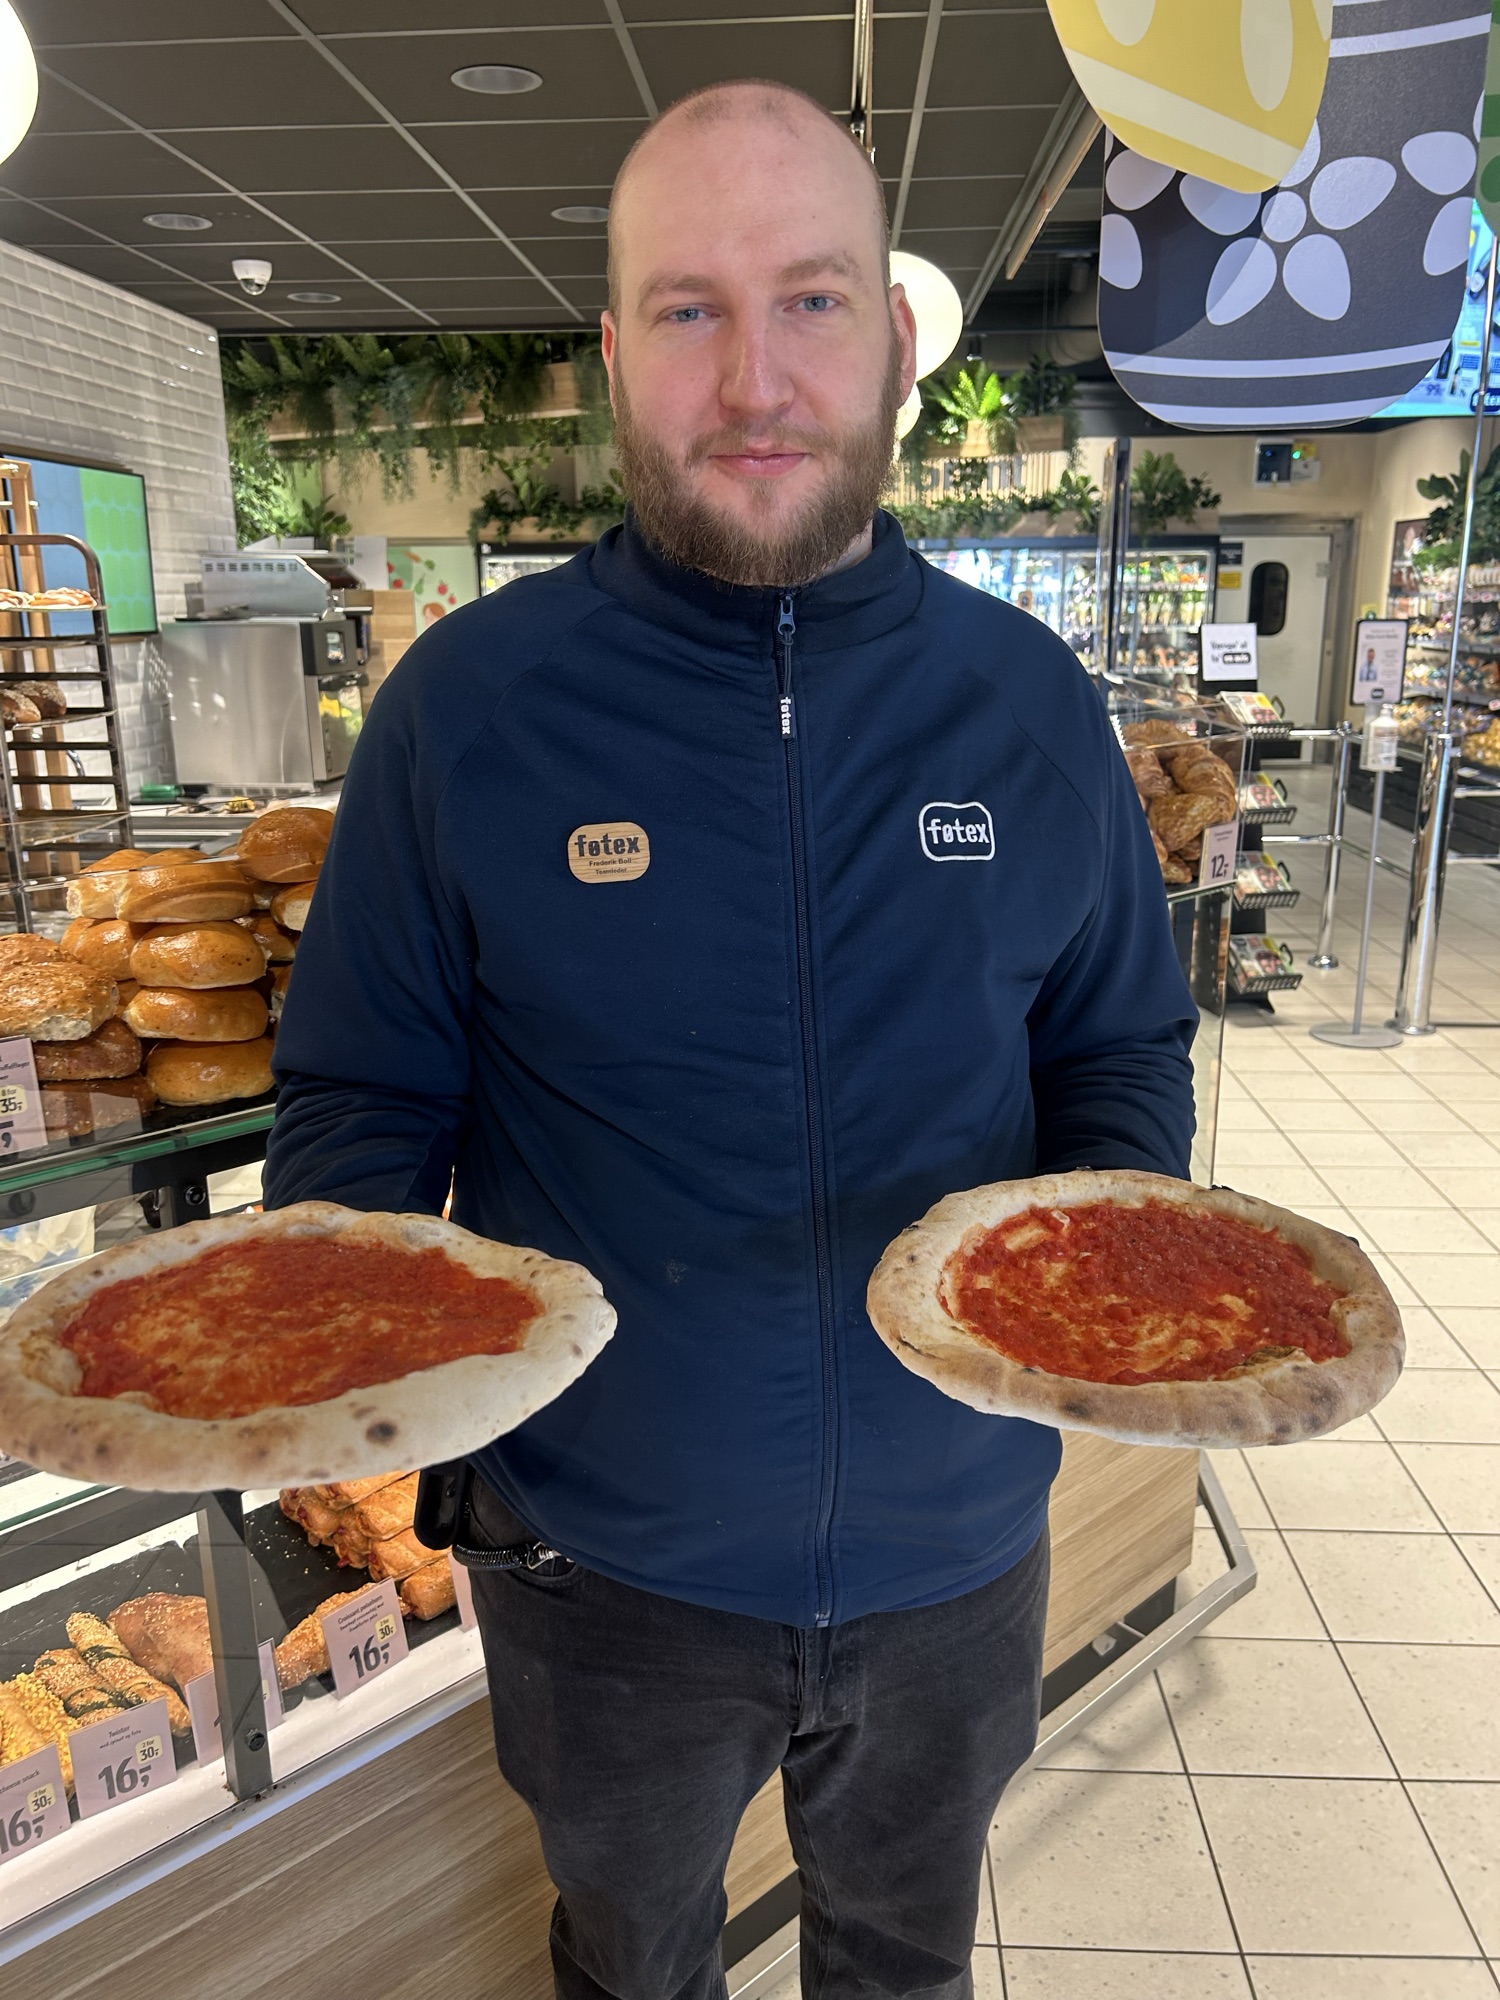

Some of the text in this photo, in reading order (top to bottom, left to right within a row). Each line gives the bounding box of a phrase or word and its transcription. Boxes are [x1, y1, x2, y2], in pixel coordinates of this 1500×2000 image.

[780, 696, 792, 735] føtex
[926, 818, 990, 844] føtex
[574, 833, 640, 857] føtex
[7, 1088, 17, 1096] for
[108, 1726, 130, 1738] Twister
[22, 1769, 40, 1783] snack
